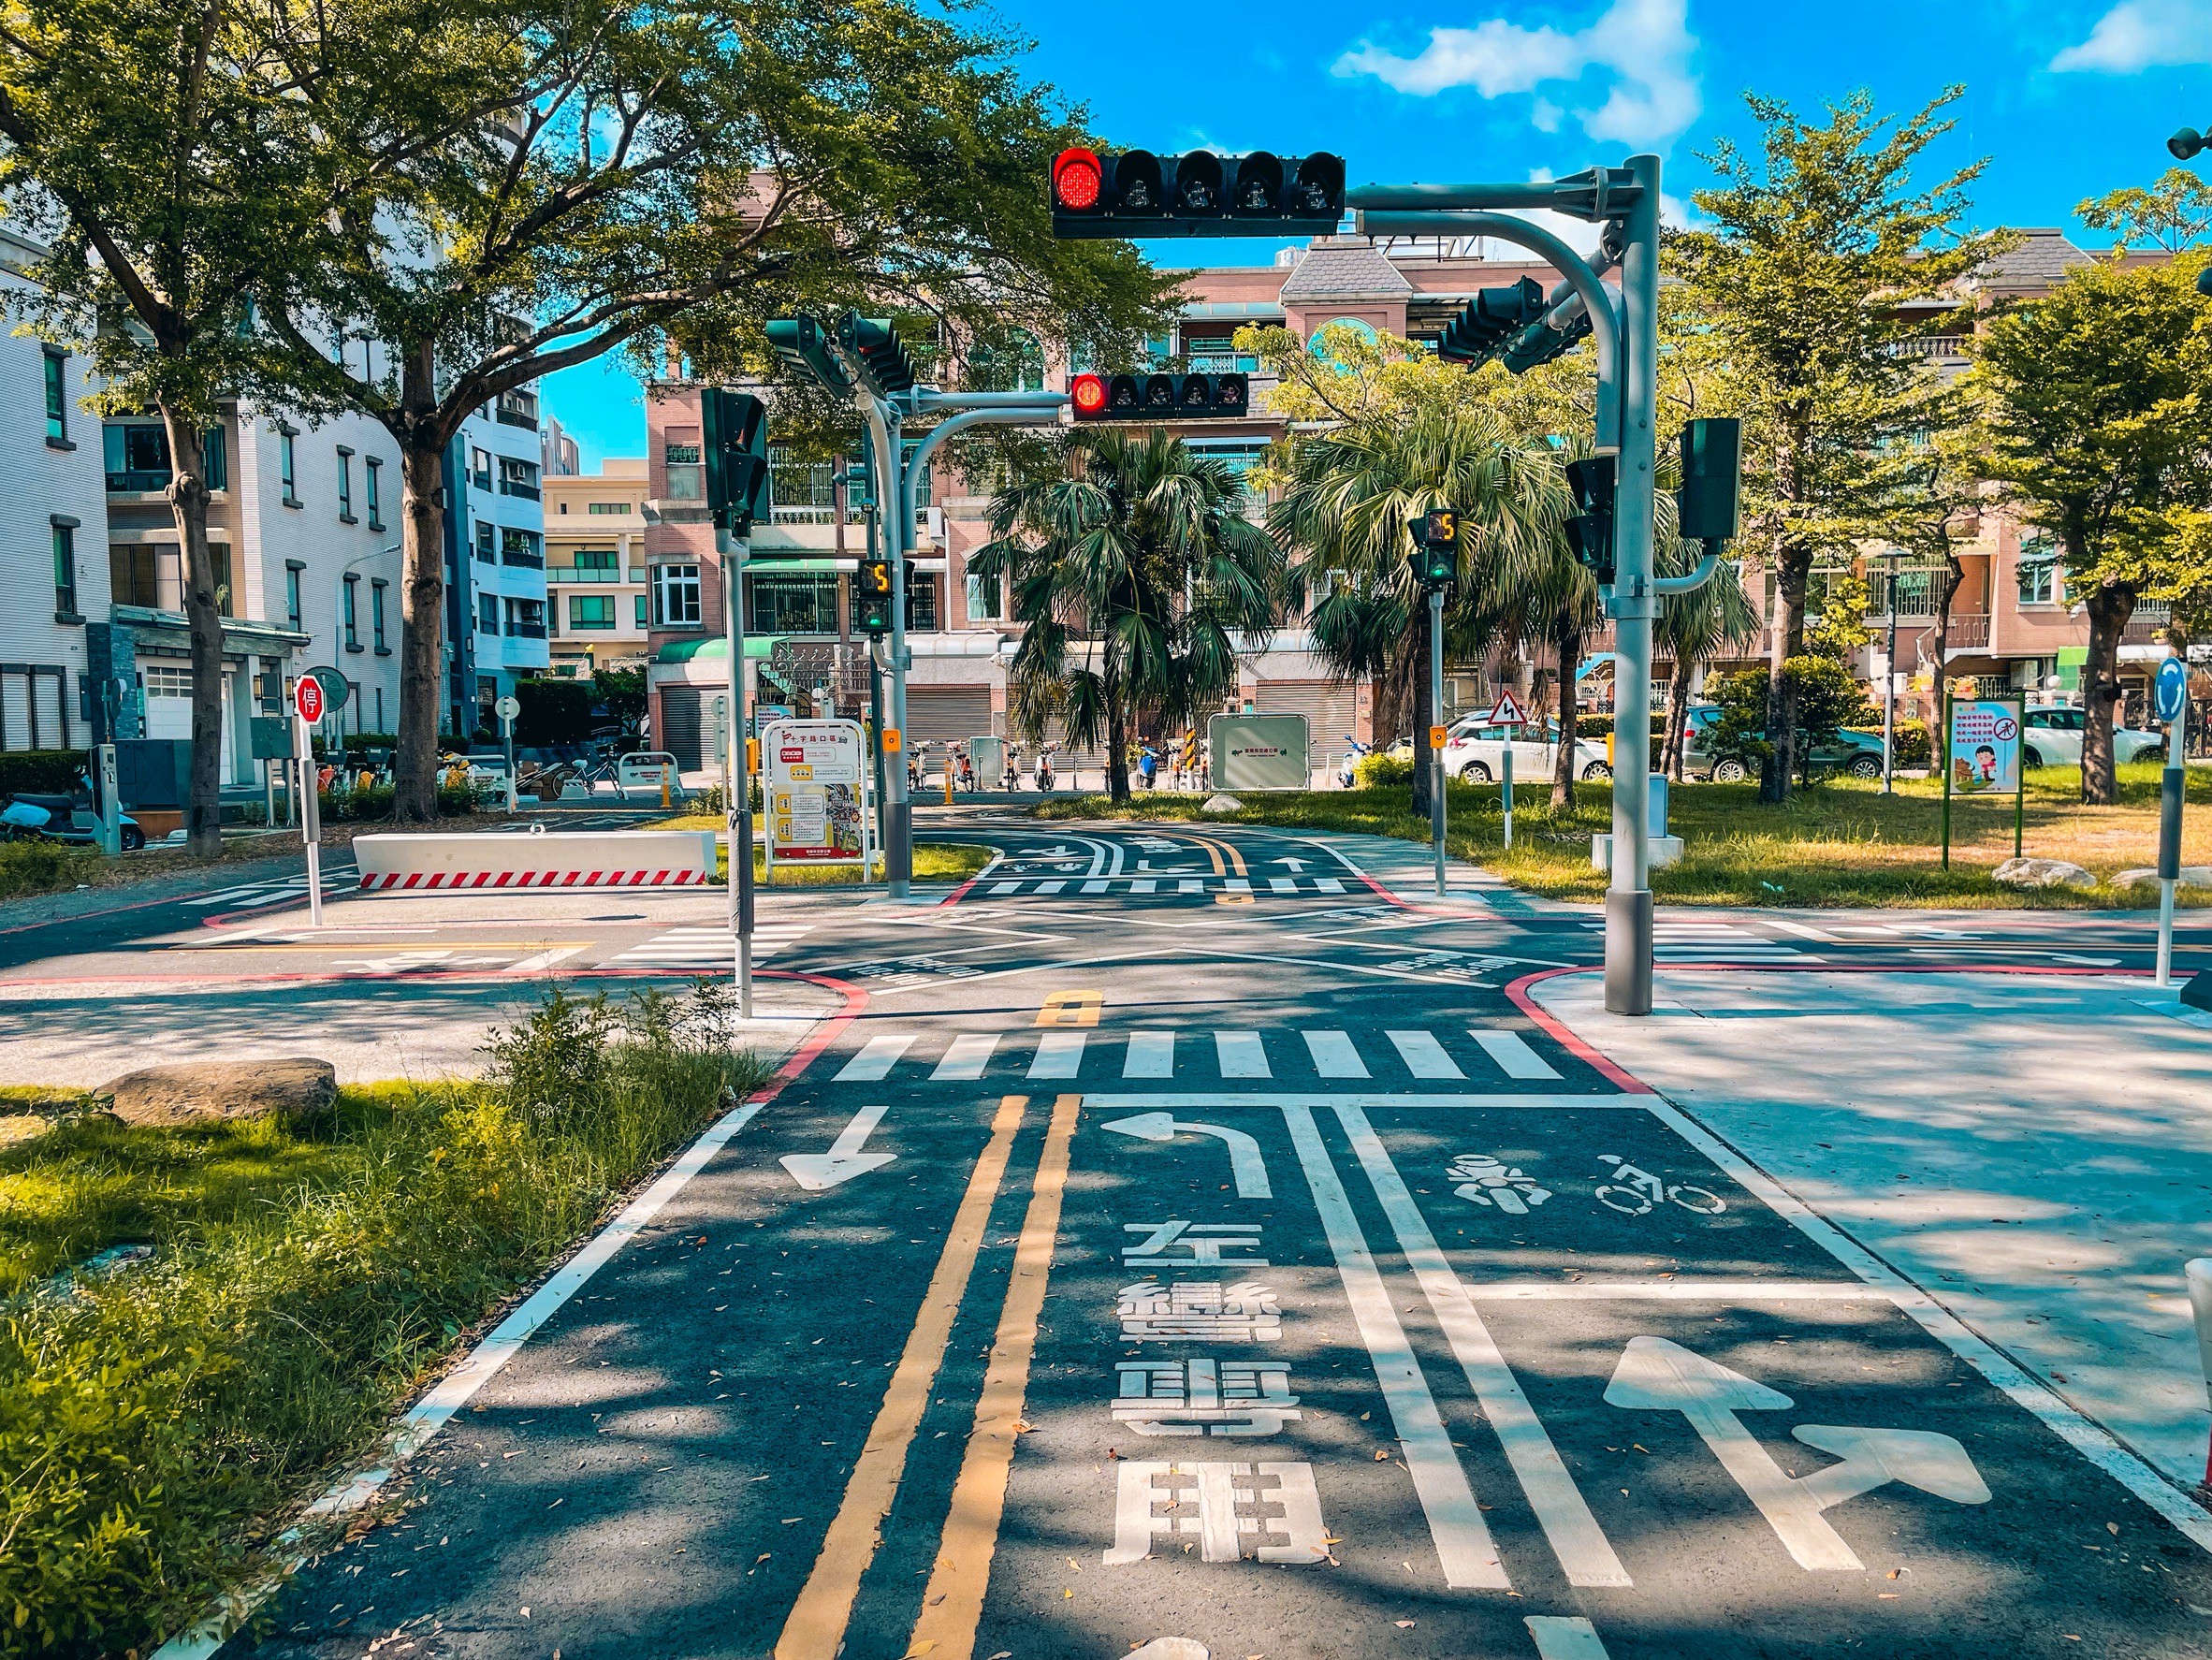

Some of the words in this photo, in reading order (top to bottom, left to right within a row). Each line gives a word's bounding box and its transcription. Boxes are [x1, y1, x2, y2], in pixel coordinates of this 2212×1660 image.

[1441, 513, 1454, 540] 5
[874, 563, 889, 591] 5
[302, 687, 318, 714] 停
[790, 735, 837, 743] 十字路口區
[1377, 953, 1463, 971] 09:00
[1435, 958, 1518, 979] 18:00
